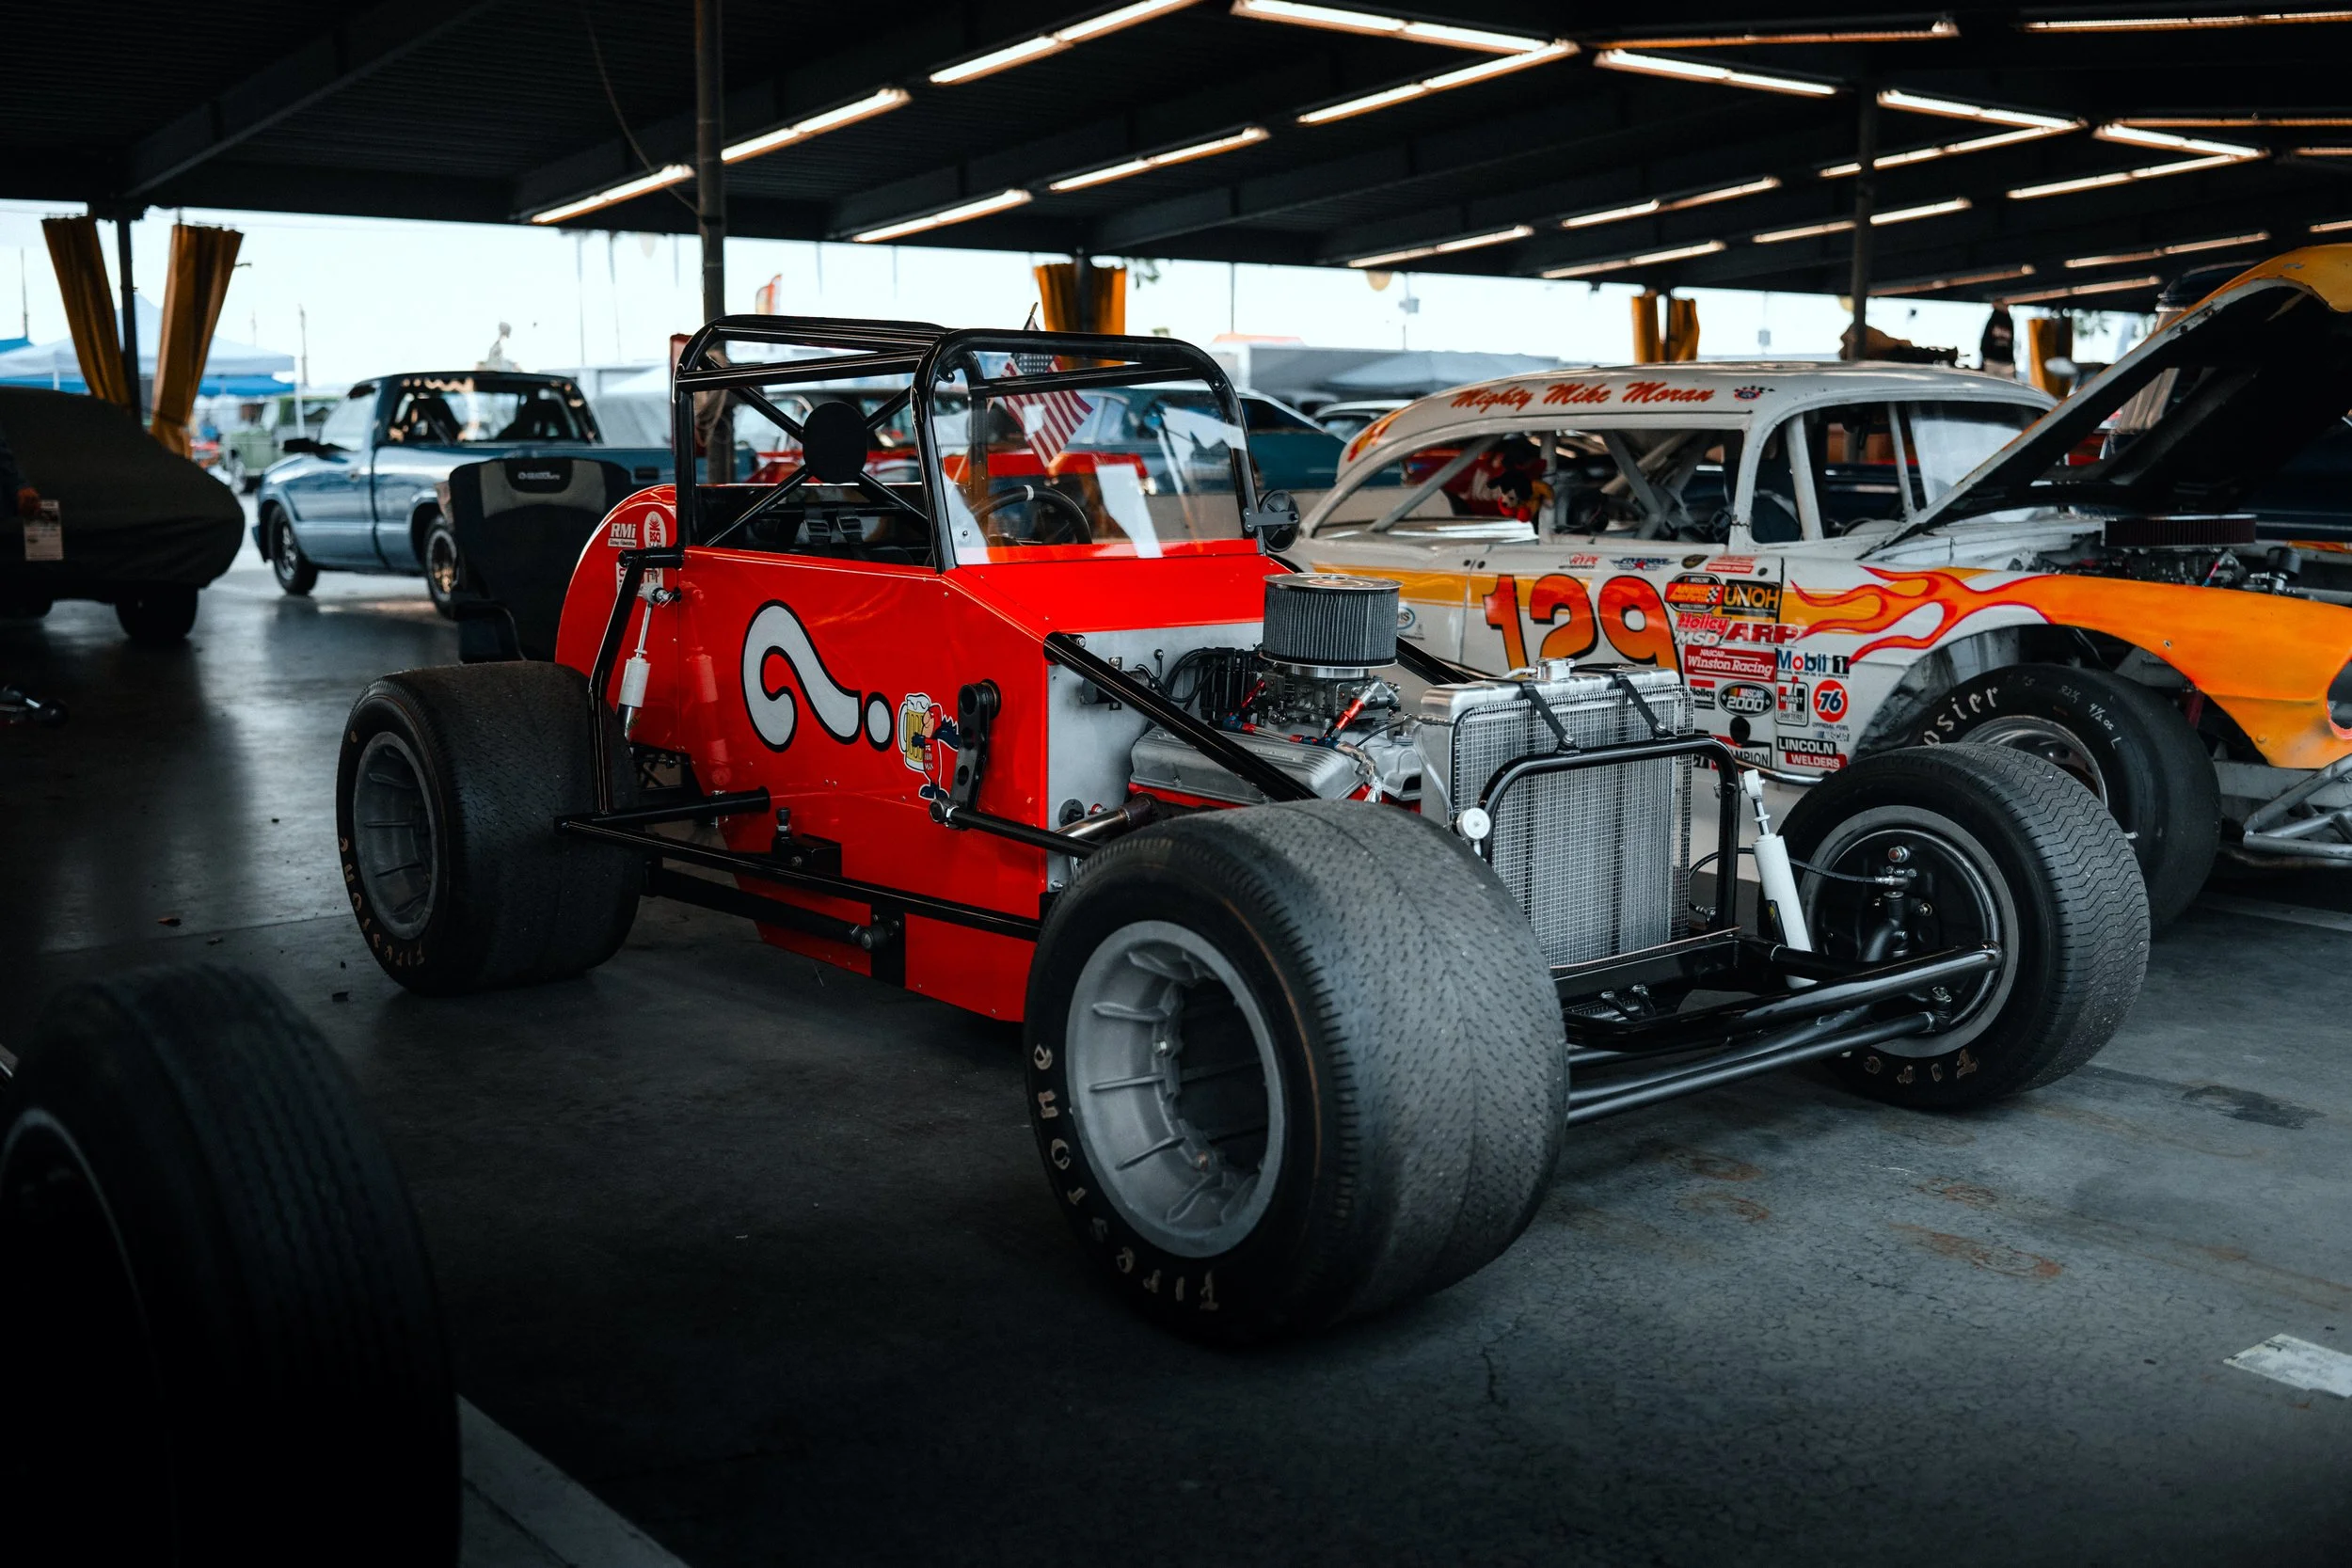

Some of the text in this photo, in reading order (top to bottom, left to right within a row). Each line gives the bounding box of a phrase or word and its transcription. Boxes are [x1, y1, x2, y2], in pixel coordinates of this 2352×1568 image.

[1450, 380, 1716, 414] Mighty Mike Moran
[610, 522, 637, 539] RMi
[1723, 583, 1780, 610] UNOH
[1483, 572, 1684, 689] 129
[1677, 611, 1730, 637] Holley
[1724, 623, 1799, 645] ARP
[1674, 630, 1721, 647] MSD
[1699, 648, 1725, 657] NASCAR
[1776, 650, 1827, 673] Mobil
[1687, 655, 1773, 677] Winston Racing
[1740, 686, 1765, 698] NASCAR
[1779, 694, 1804, 705] HURST
[1817, 689, 1844, 714] 76
[1725, 697, 1765, 713] 2000
[1777, 737, 1836, 755] LINCOLN
[1790, 753, 1841, 769] WELDERS
